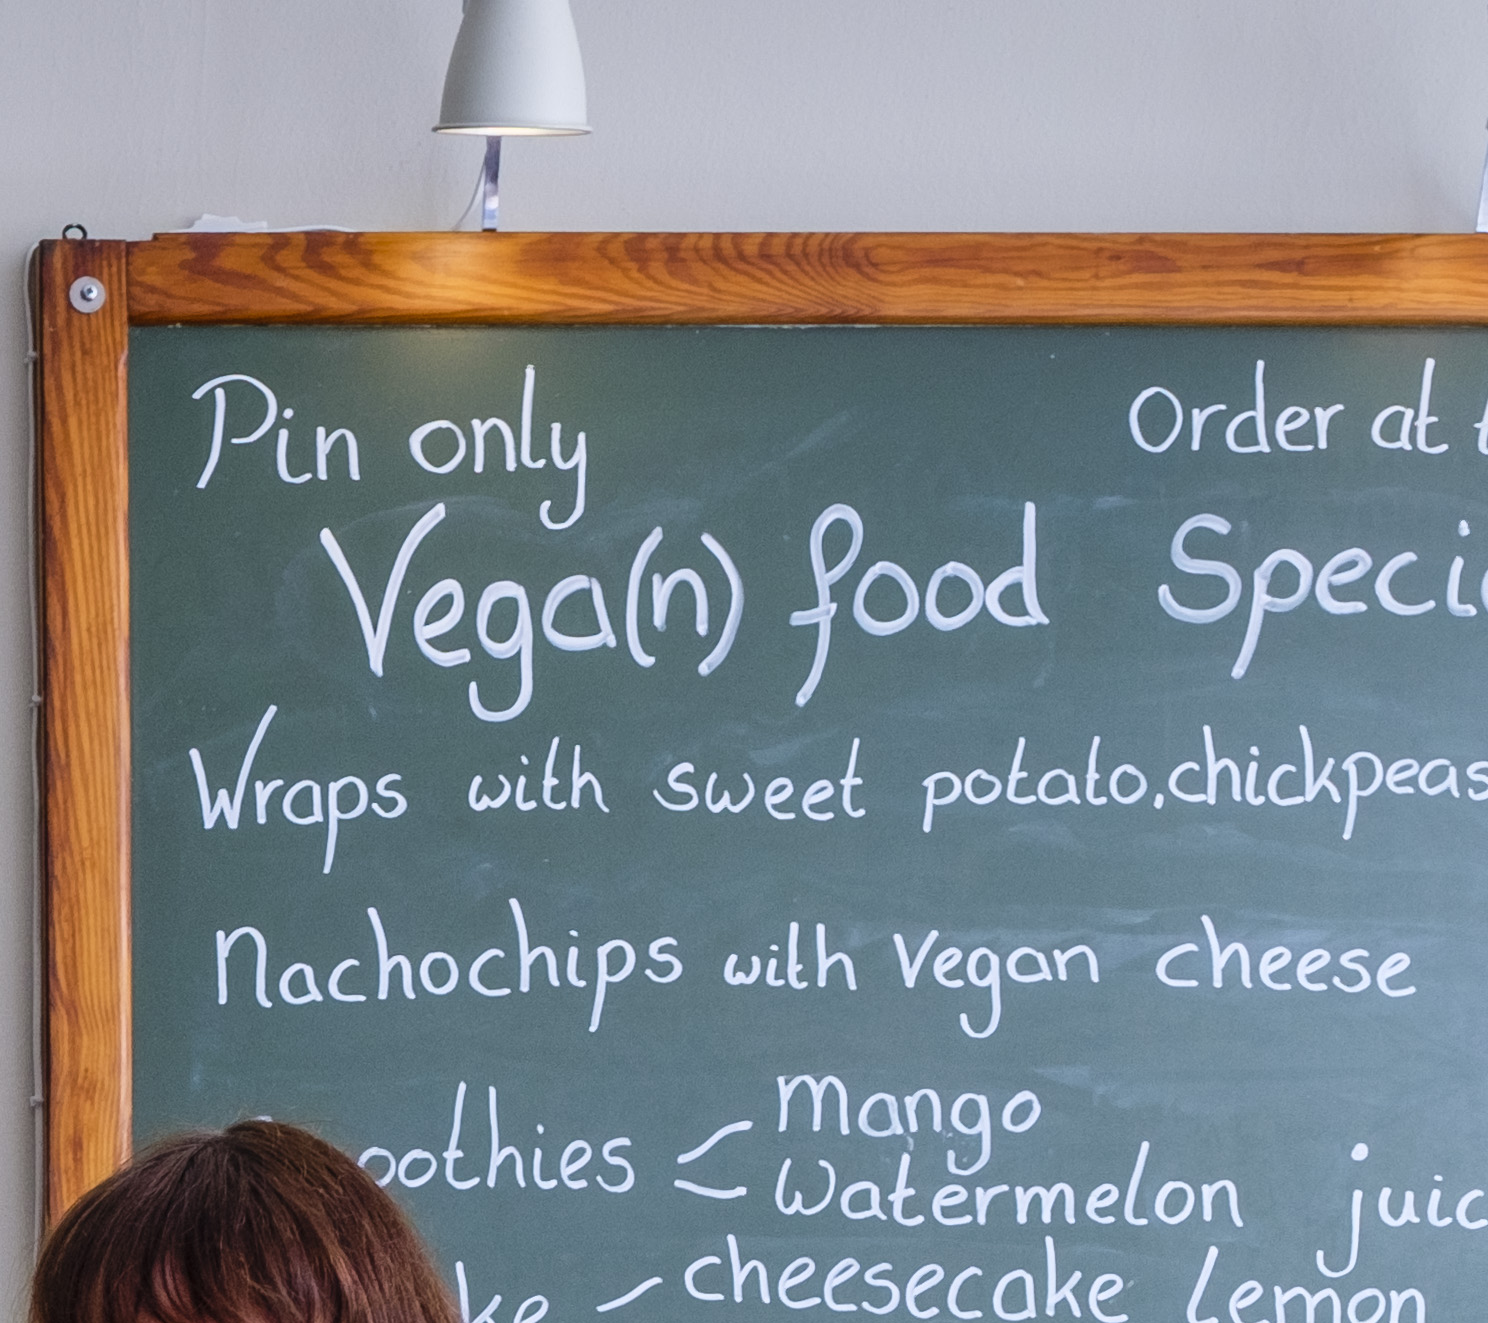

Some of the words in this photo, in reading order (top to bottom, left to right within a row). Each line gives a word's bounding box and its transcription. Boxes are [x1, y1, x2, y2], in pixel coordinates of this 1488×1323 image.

[192, 374, 361, 489] Pin
[409, 364, 587, 530] only
[1128, 359, 1345, 455] Order
[1371, 357, 1450, 455] at
[319, 502, 744, 722] Vega(n)
[789, 501, 1050, 707] food
[189, 704, 408, 875] Wraps
[467, 735, 610, 815] with
[653, 737, 867, 822] sweet
[723, 921, 858, 992] with
[892, 928, 1100, 1039] Vegan
[1155, 914, 1418, 997] cheese
[683, 1234, 1130, 1323] cheesecake
